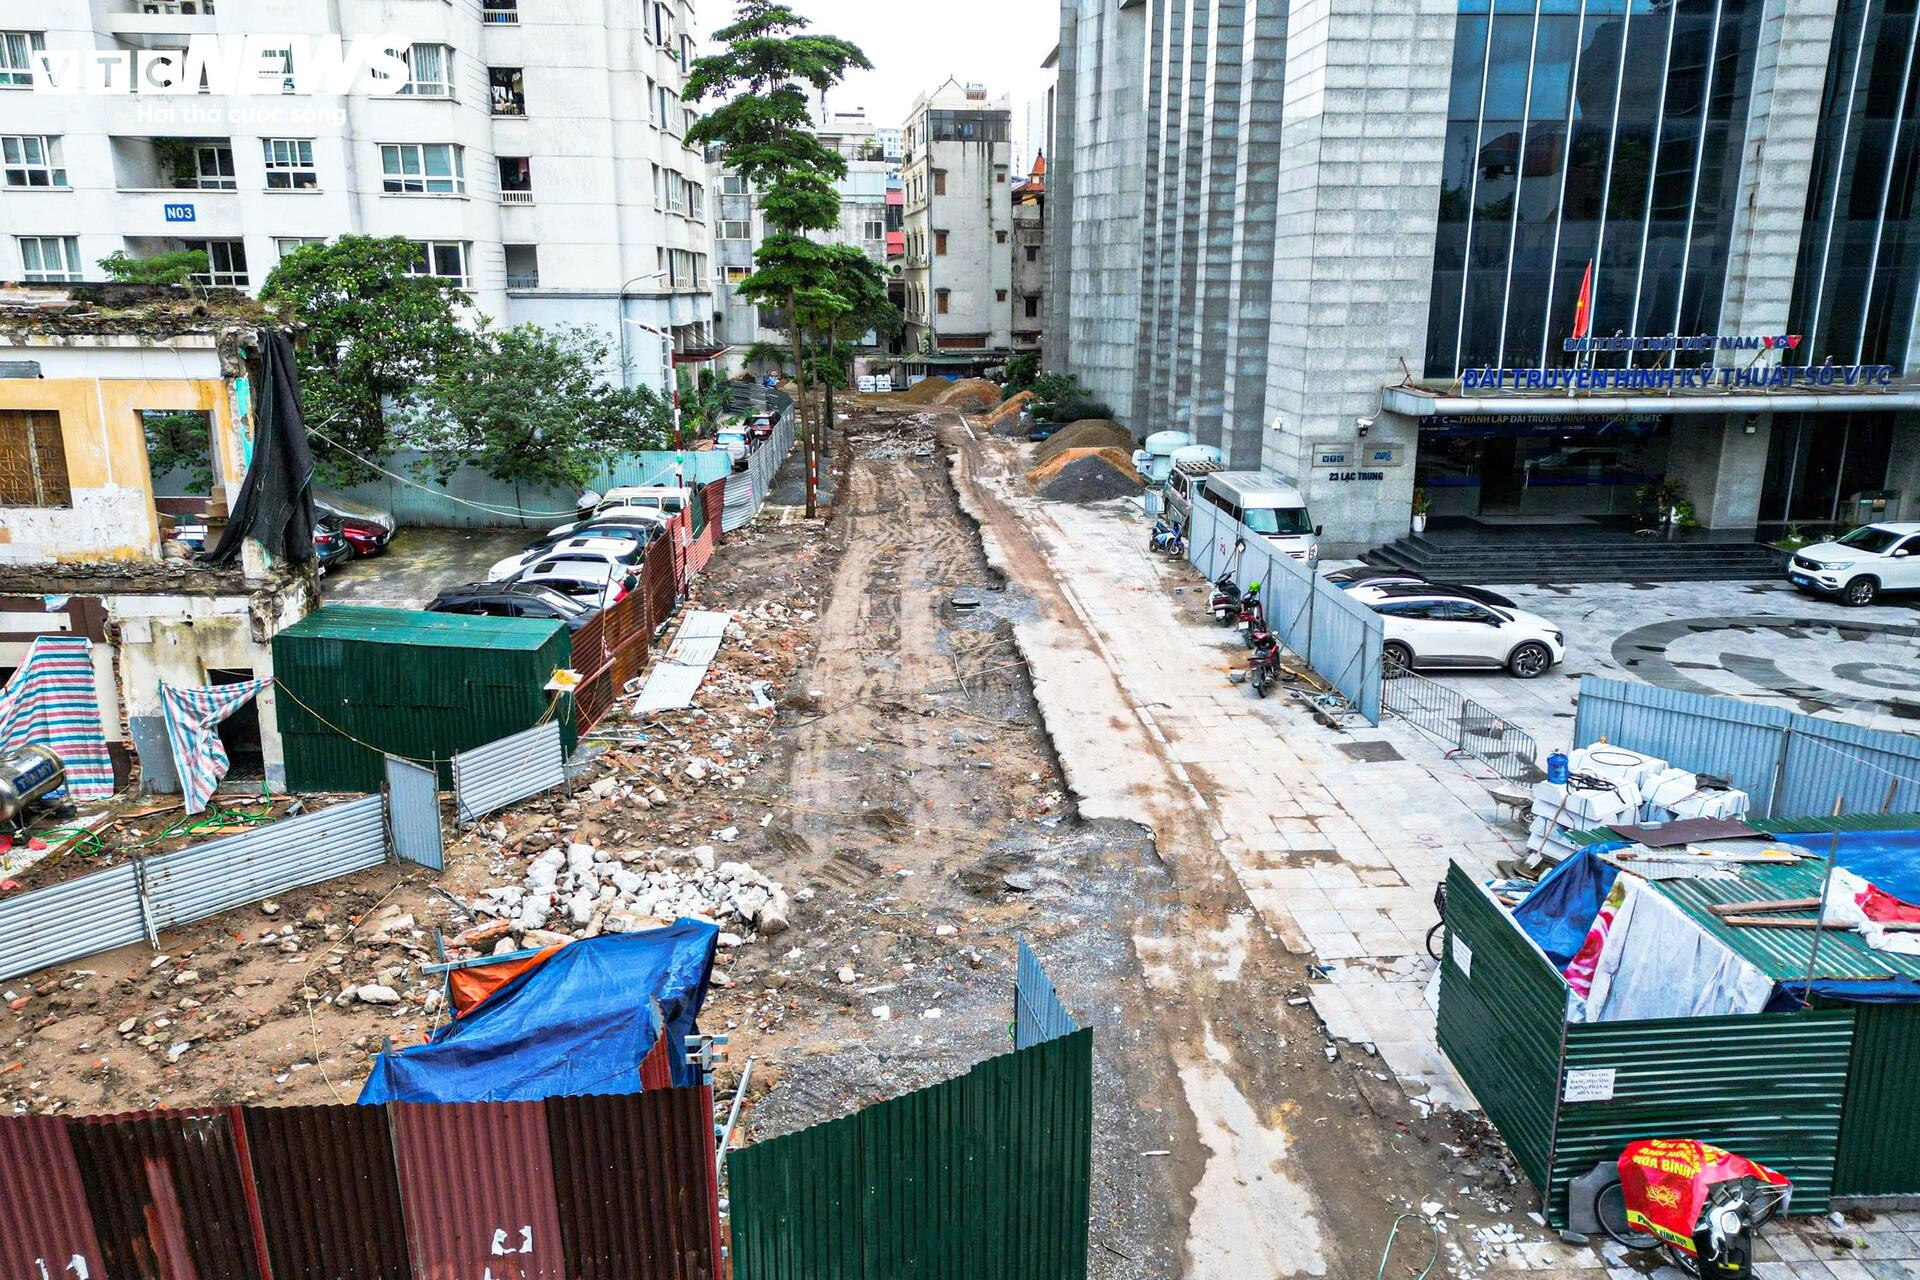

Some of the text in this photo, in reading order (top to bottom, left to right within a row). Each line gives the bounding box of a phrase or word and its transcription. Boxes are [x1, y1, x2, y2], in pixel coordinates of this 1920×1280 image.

[1682, 334, 1718, 351] VIỆT
[1720, 336, 1760, 350] NAM
[1761, 335, 1803, 350] VOV
[1463, 364, 1503, 389] ĐÀI
[1509, 360, 1608, 389] TRUYỀN
[1613, 364, 1675, 389] HÌNH
[1720, 361, 1800, 391] THUẬT
[1803, 355, 1835, 386] SỐ
[1843, 364, 1895, 386] VTC
[1329, 472, 1384, 482] 23 LẠC TRUNG
